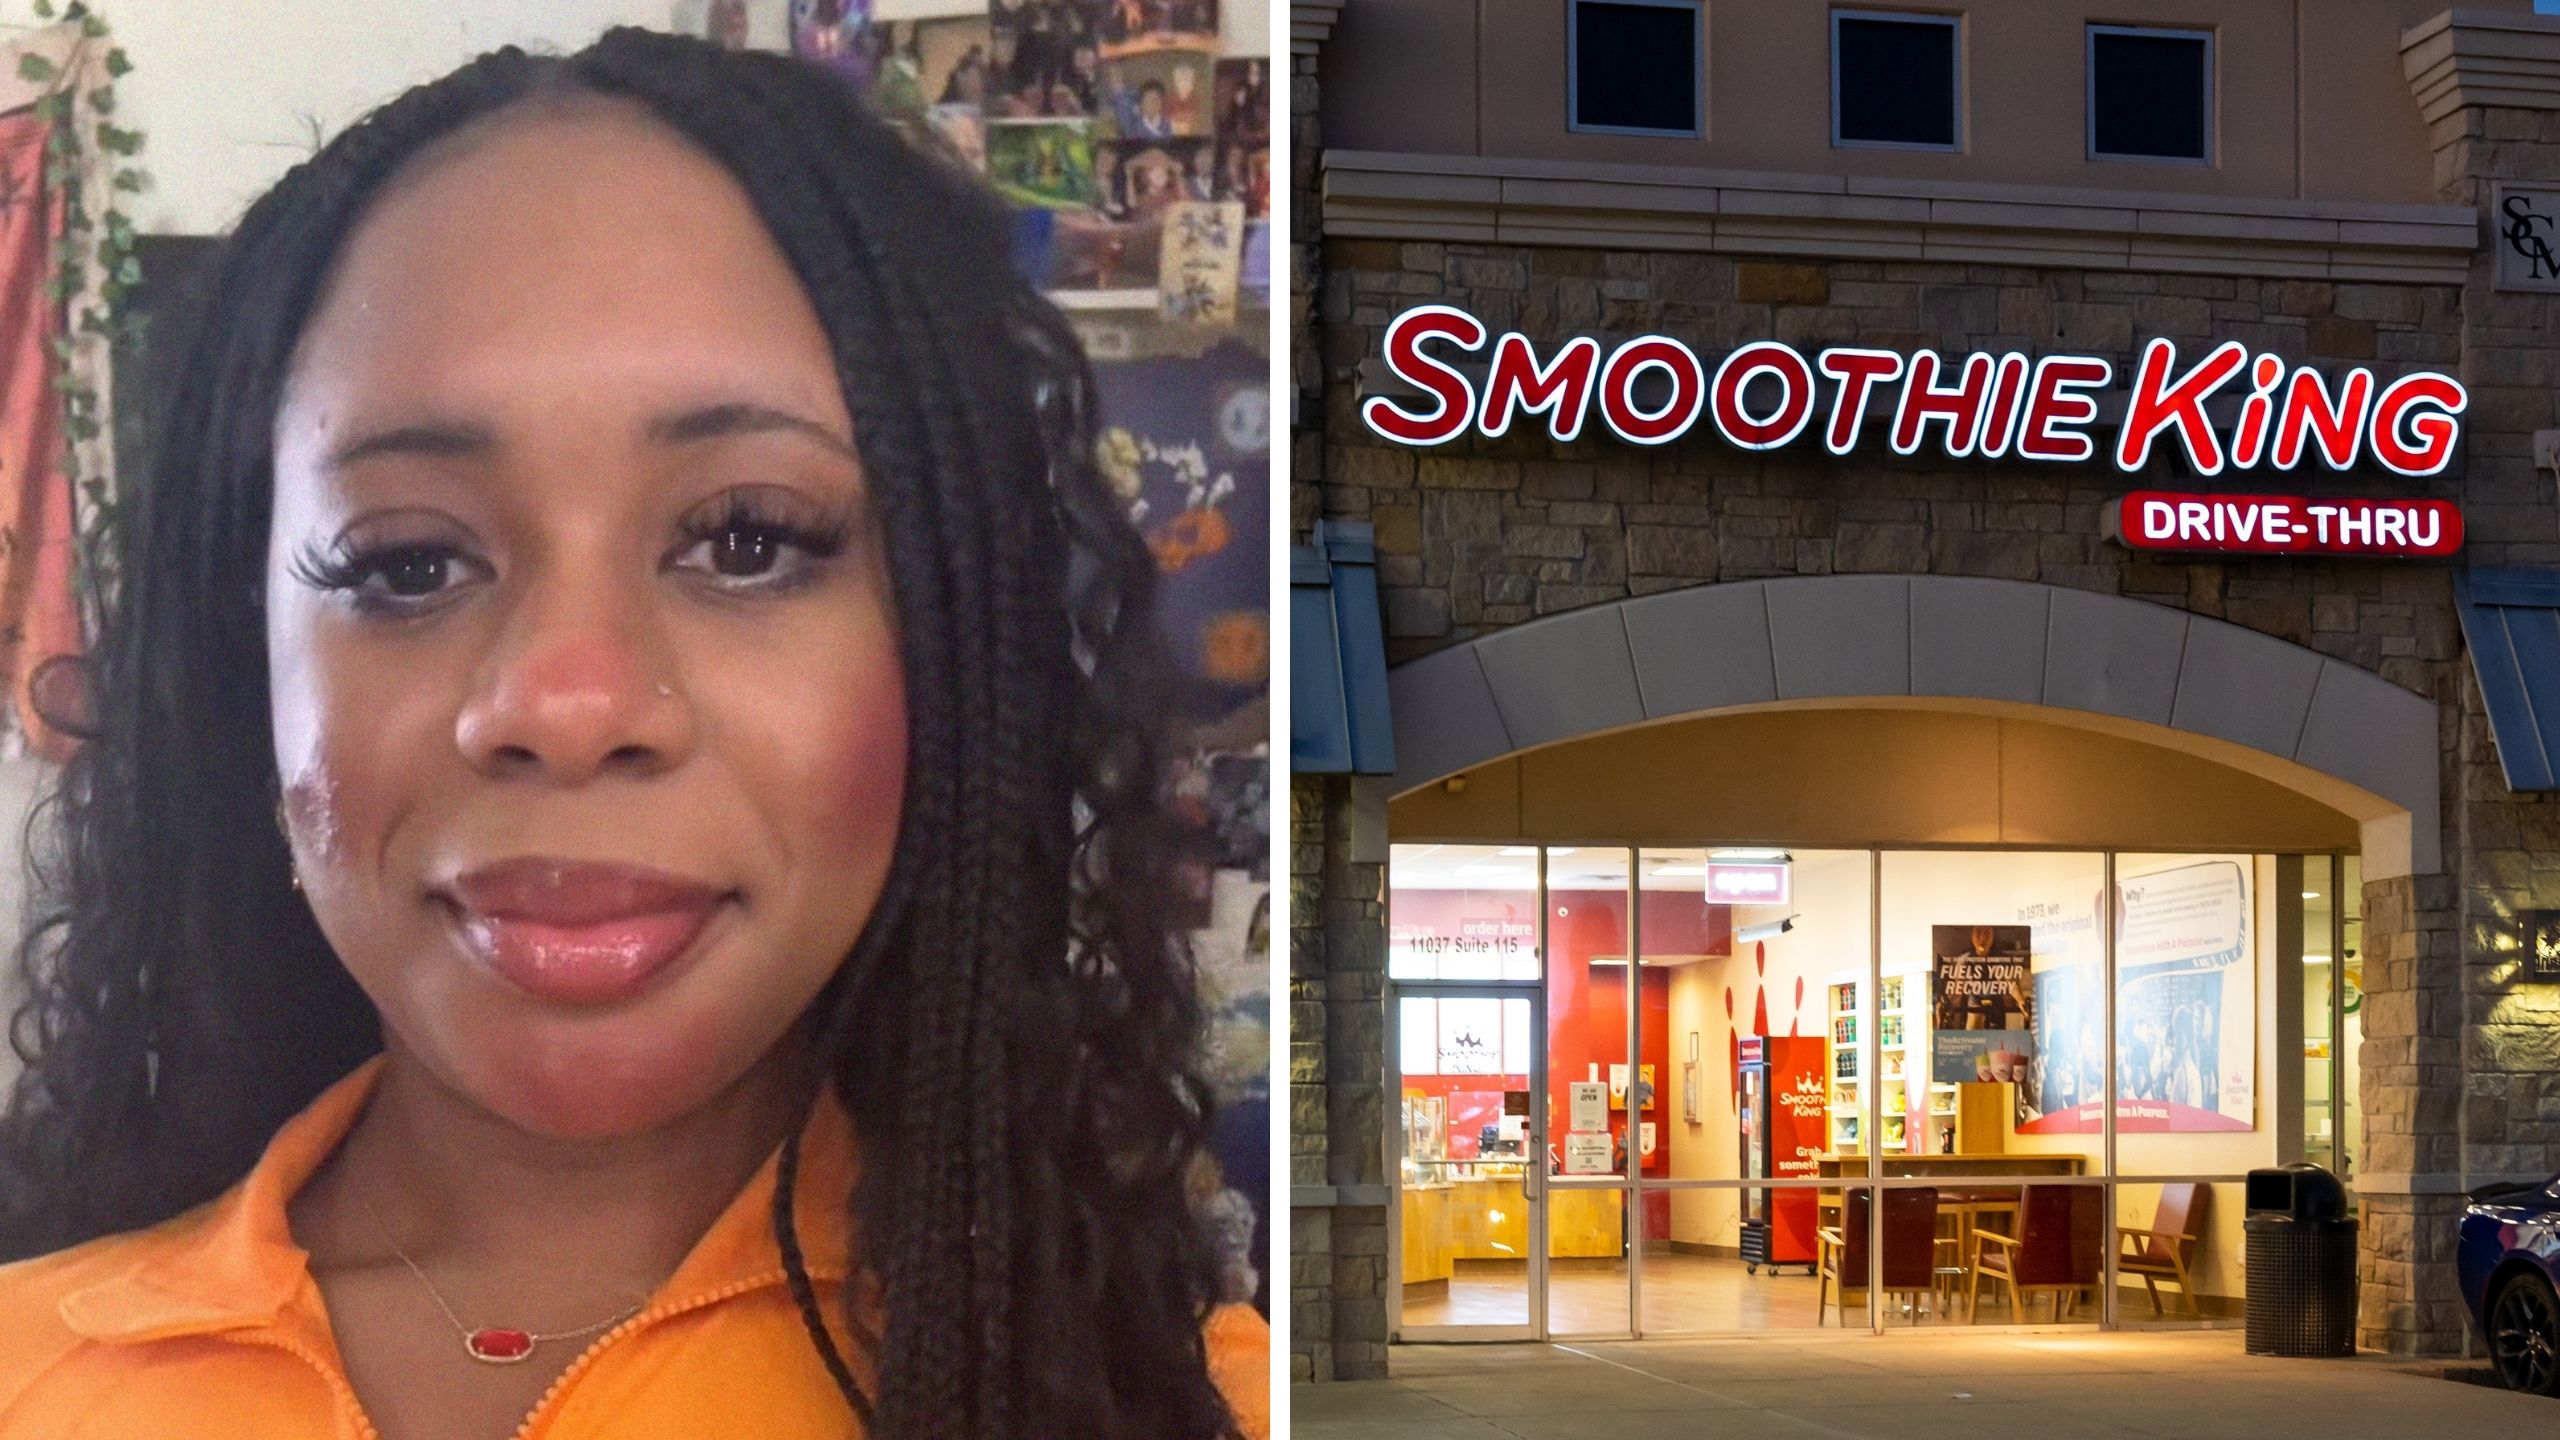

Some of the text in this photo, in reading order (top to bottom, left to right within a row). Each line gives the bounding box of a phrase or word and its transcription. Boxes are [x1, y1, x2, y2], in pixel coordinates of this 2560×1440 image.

[1362, 304, 2113, 461] SMOOTHIE
[2142, 501, 2441, 548] DRIVE-THRU
[2126, 887, 2145, 903] Why?
[2017, 907, 2025, 921] In
[1463, 921, 1534, 936] order here
[1410, 937, 1518, 953] 11037 Suite 115
[1940, 964, 2024, 980] FUELS YOUR
[1945, 980, 2017, 995] RECOVERY
[1779, 1092, 1827, 1106] SMOOTH
[1796, 1146, 1822, 1157] Grab
[1779, 1160, 1820, 1170] someth
